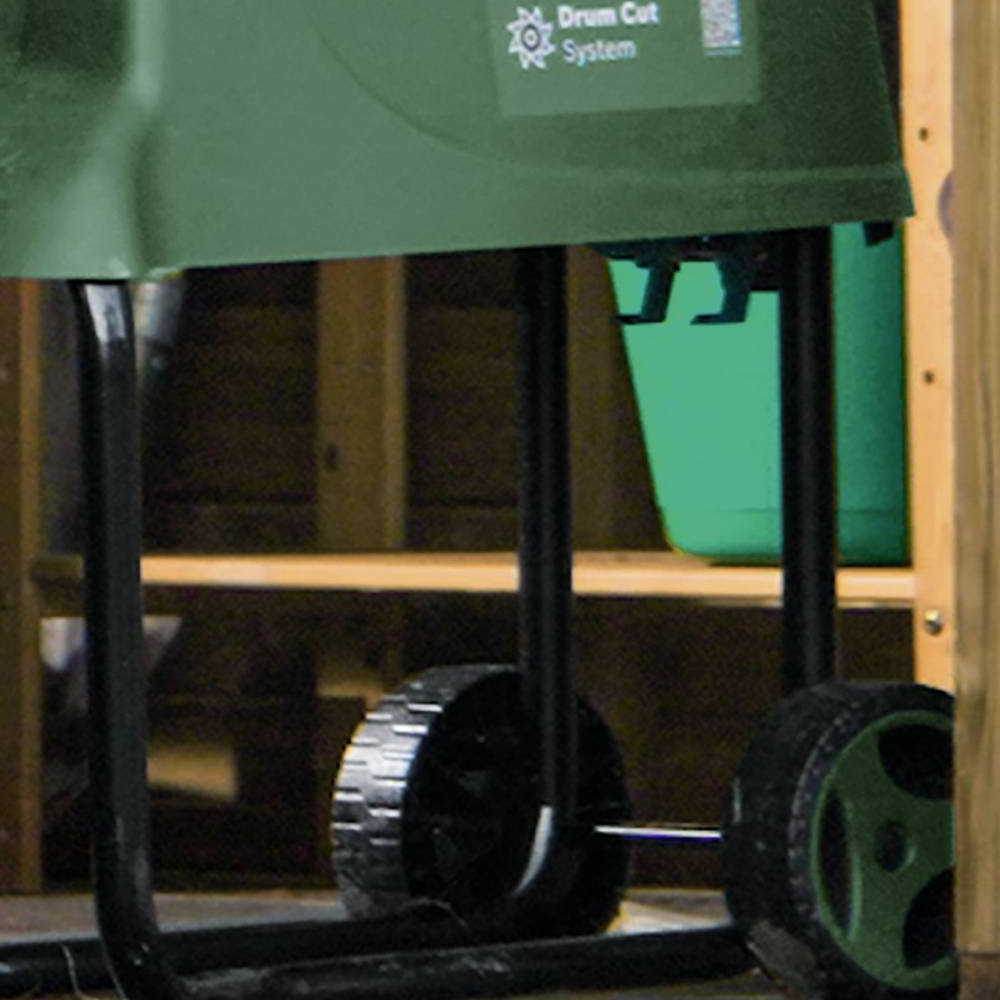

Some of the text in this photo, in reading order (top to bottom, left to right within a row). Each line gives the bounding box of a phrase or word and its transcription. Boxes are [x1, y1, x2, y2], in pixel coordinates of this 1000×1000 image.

[557, 1, 660, 28] Drum Cut
[562, 39, 637, 67] System
